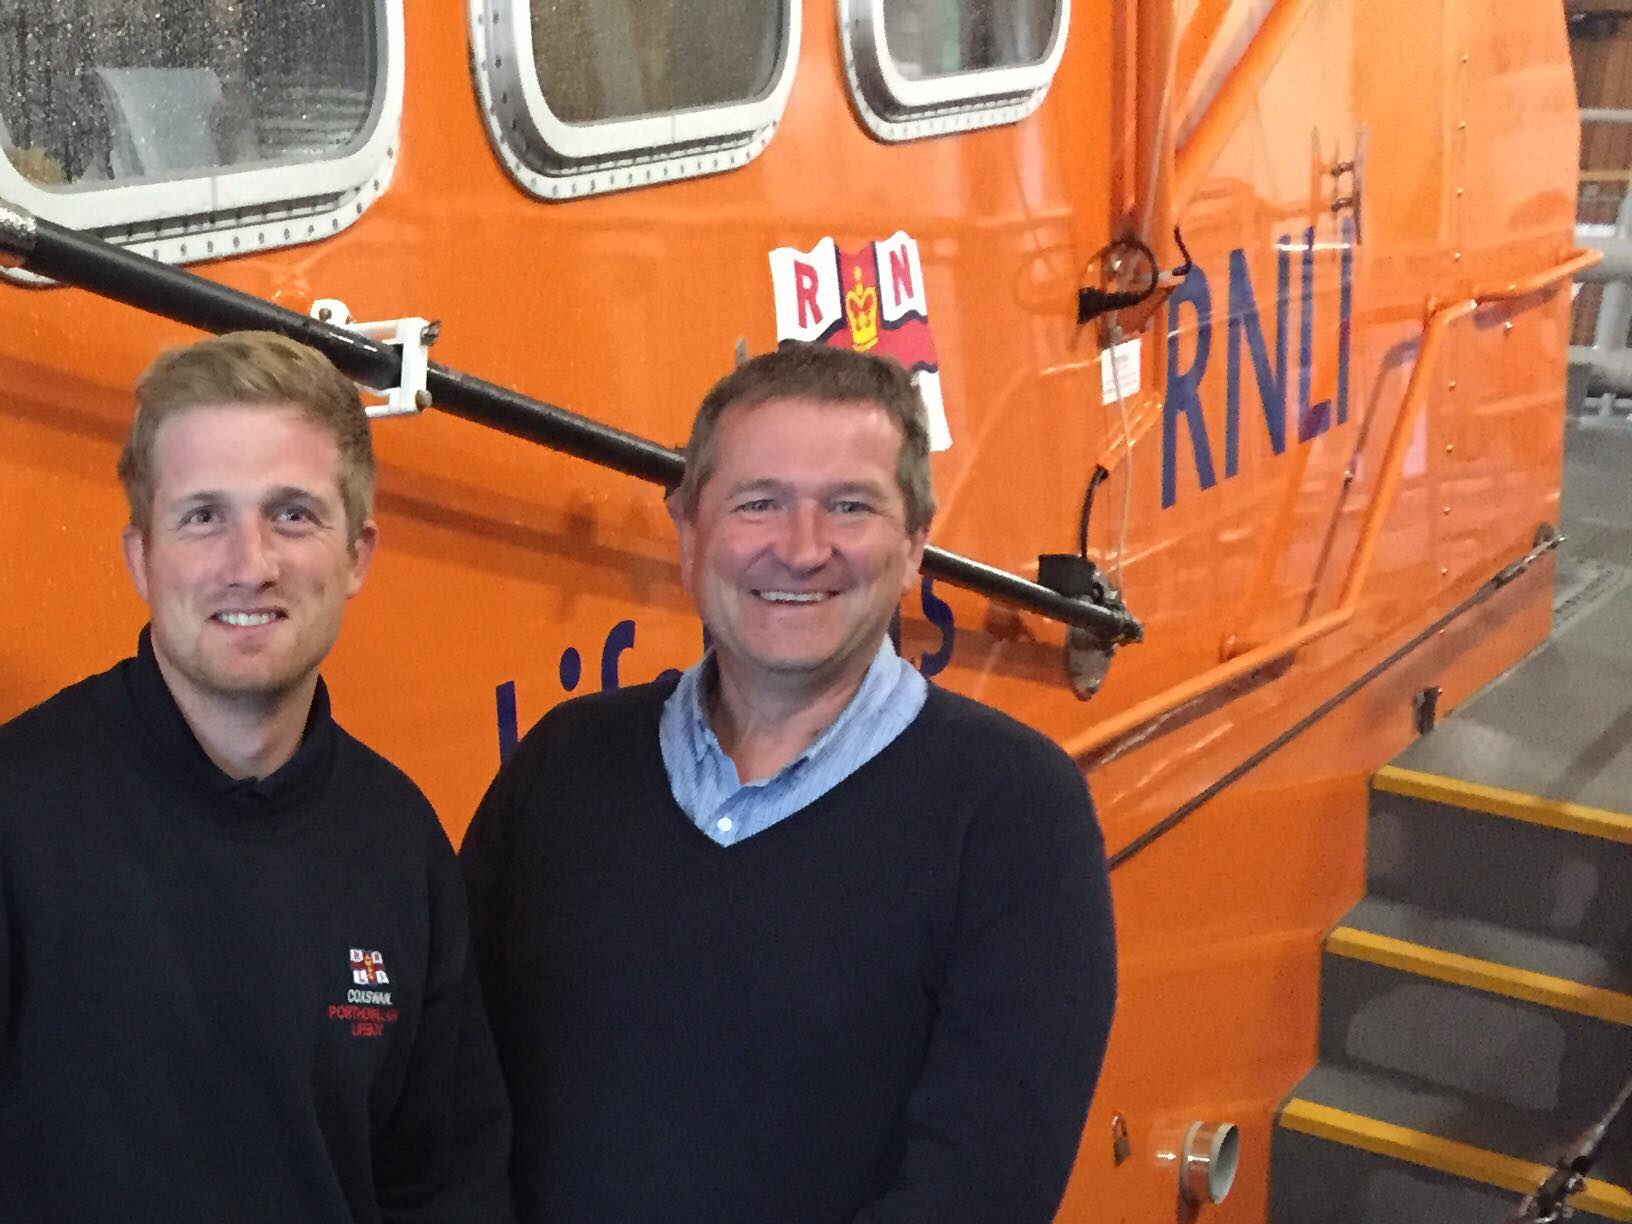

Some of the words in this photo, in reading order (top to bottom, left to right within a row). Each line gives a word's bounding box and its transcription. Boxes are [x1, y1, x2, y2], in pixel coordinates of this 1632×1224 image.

[794, 260, 824, 330] R
[889, 243, 914, 306] N
[1161, 217, 1354, 510] RNLI
